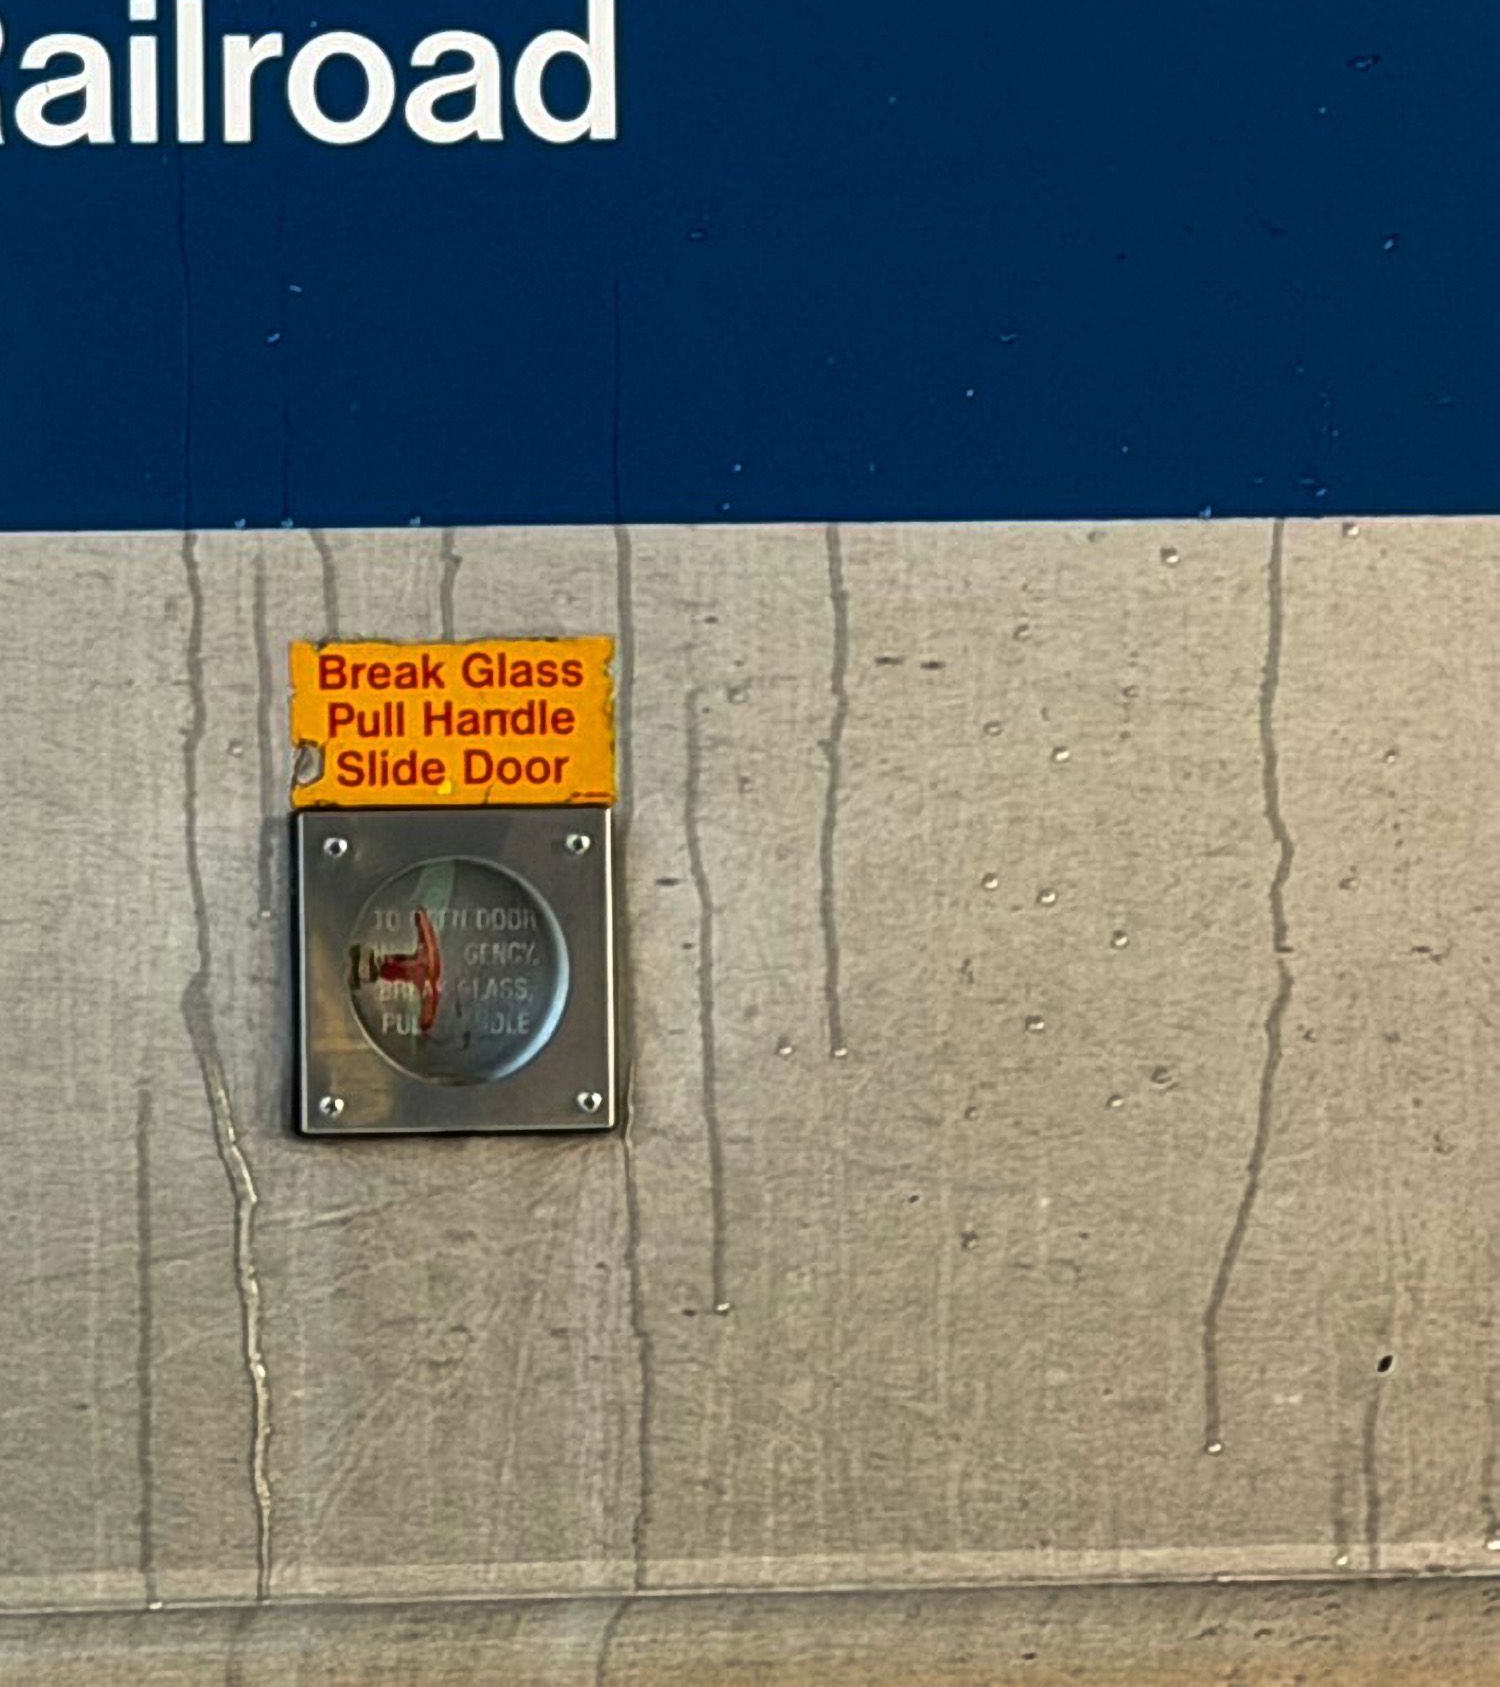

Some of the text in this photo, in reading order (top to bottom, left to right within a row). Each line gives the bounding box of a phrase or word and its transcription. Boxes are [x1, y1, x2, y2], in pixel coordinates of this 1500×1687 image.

[318, 652, 584, 690] Break Glass
[328, 700, 575, 738] Pull Handle
[336, 749, 570, 787] Slide Door
